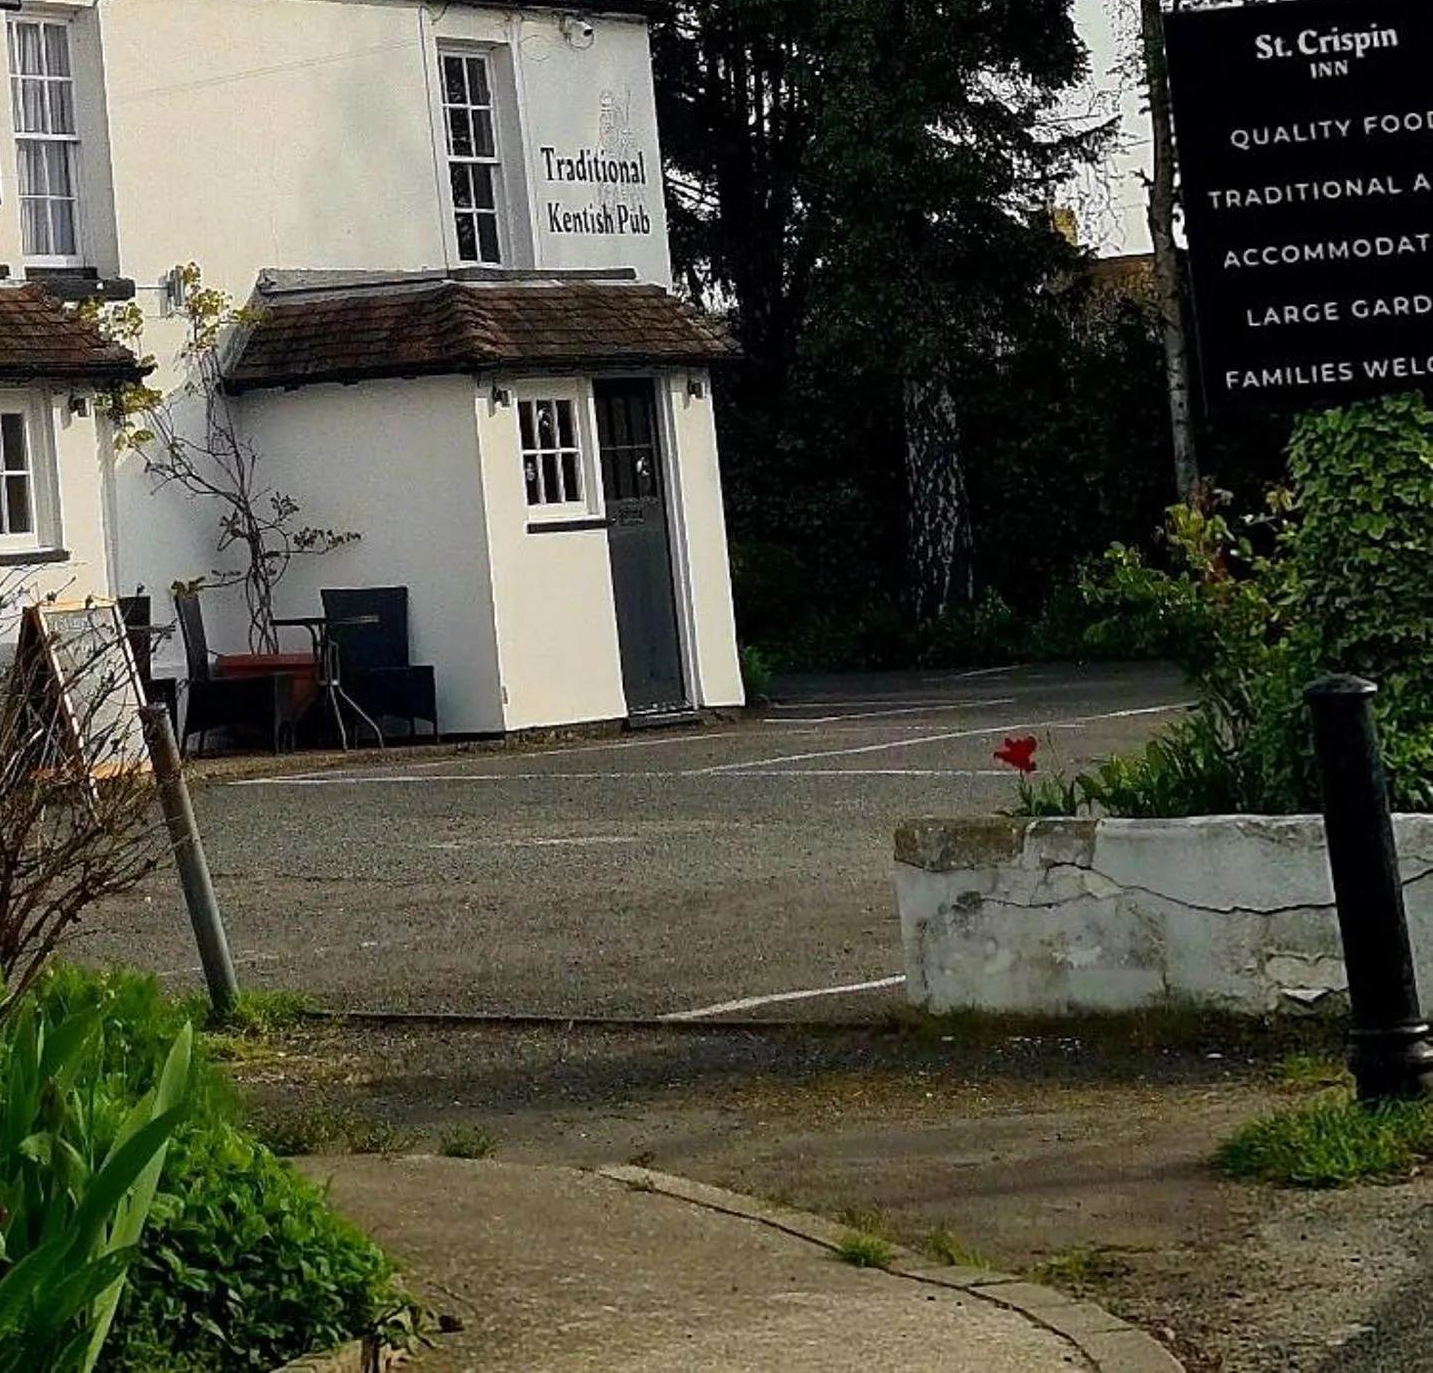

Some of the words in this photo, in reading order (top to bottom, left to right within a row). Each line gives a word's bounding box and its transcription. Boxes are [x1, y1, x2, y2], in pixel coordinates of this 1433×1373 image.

[1255, 34, 1293, 60] St.
[1297, 23, 1398, 58] Crispin
[1310, 59, 1349, 79] INN
[1229, 119, 1352, 150] QUALITY
[540, 147, 646, 185] Traditional
[1207, 176, 1403, 209] TRADITIONAL
[547, 202, 615, 234] Kentish
[616, 203, 650, 234] Pub
[1223, 233, 1431, 269] ACCOMMODAT
[1246, 301, 1341, 327] LARGE
[1351, 294, 1433, 319] GARD
[1226, 362, 1354, 390] FAMILIES
